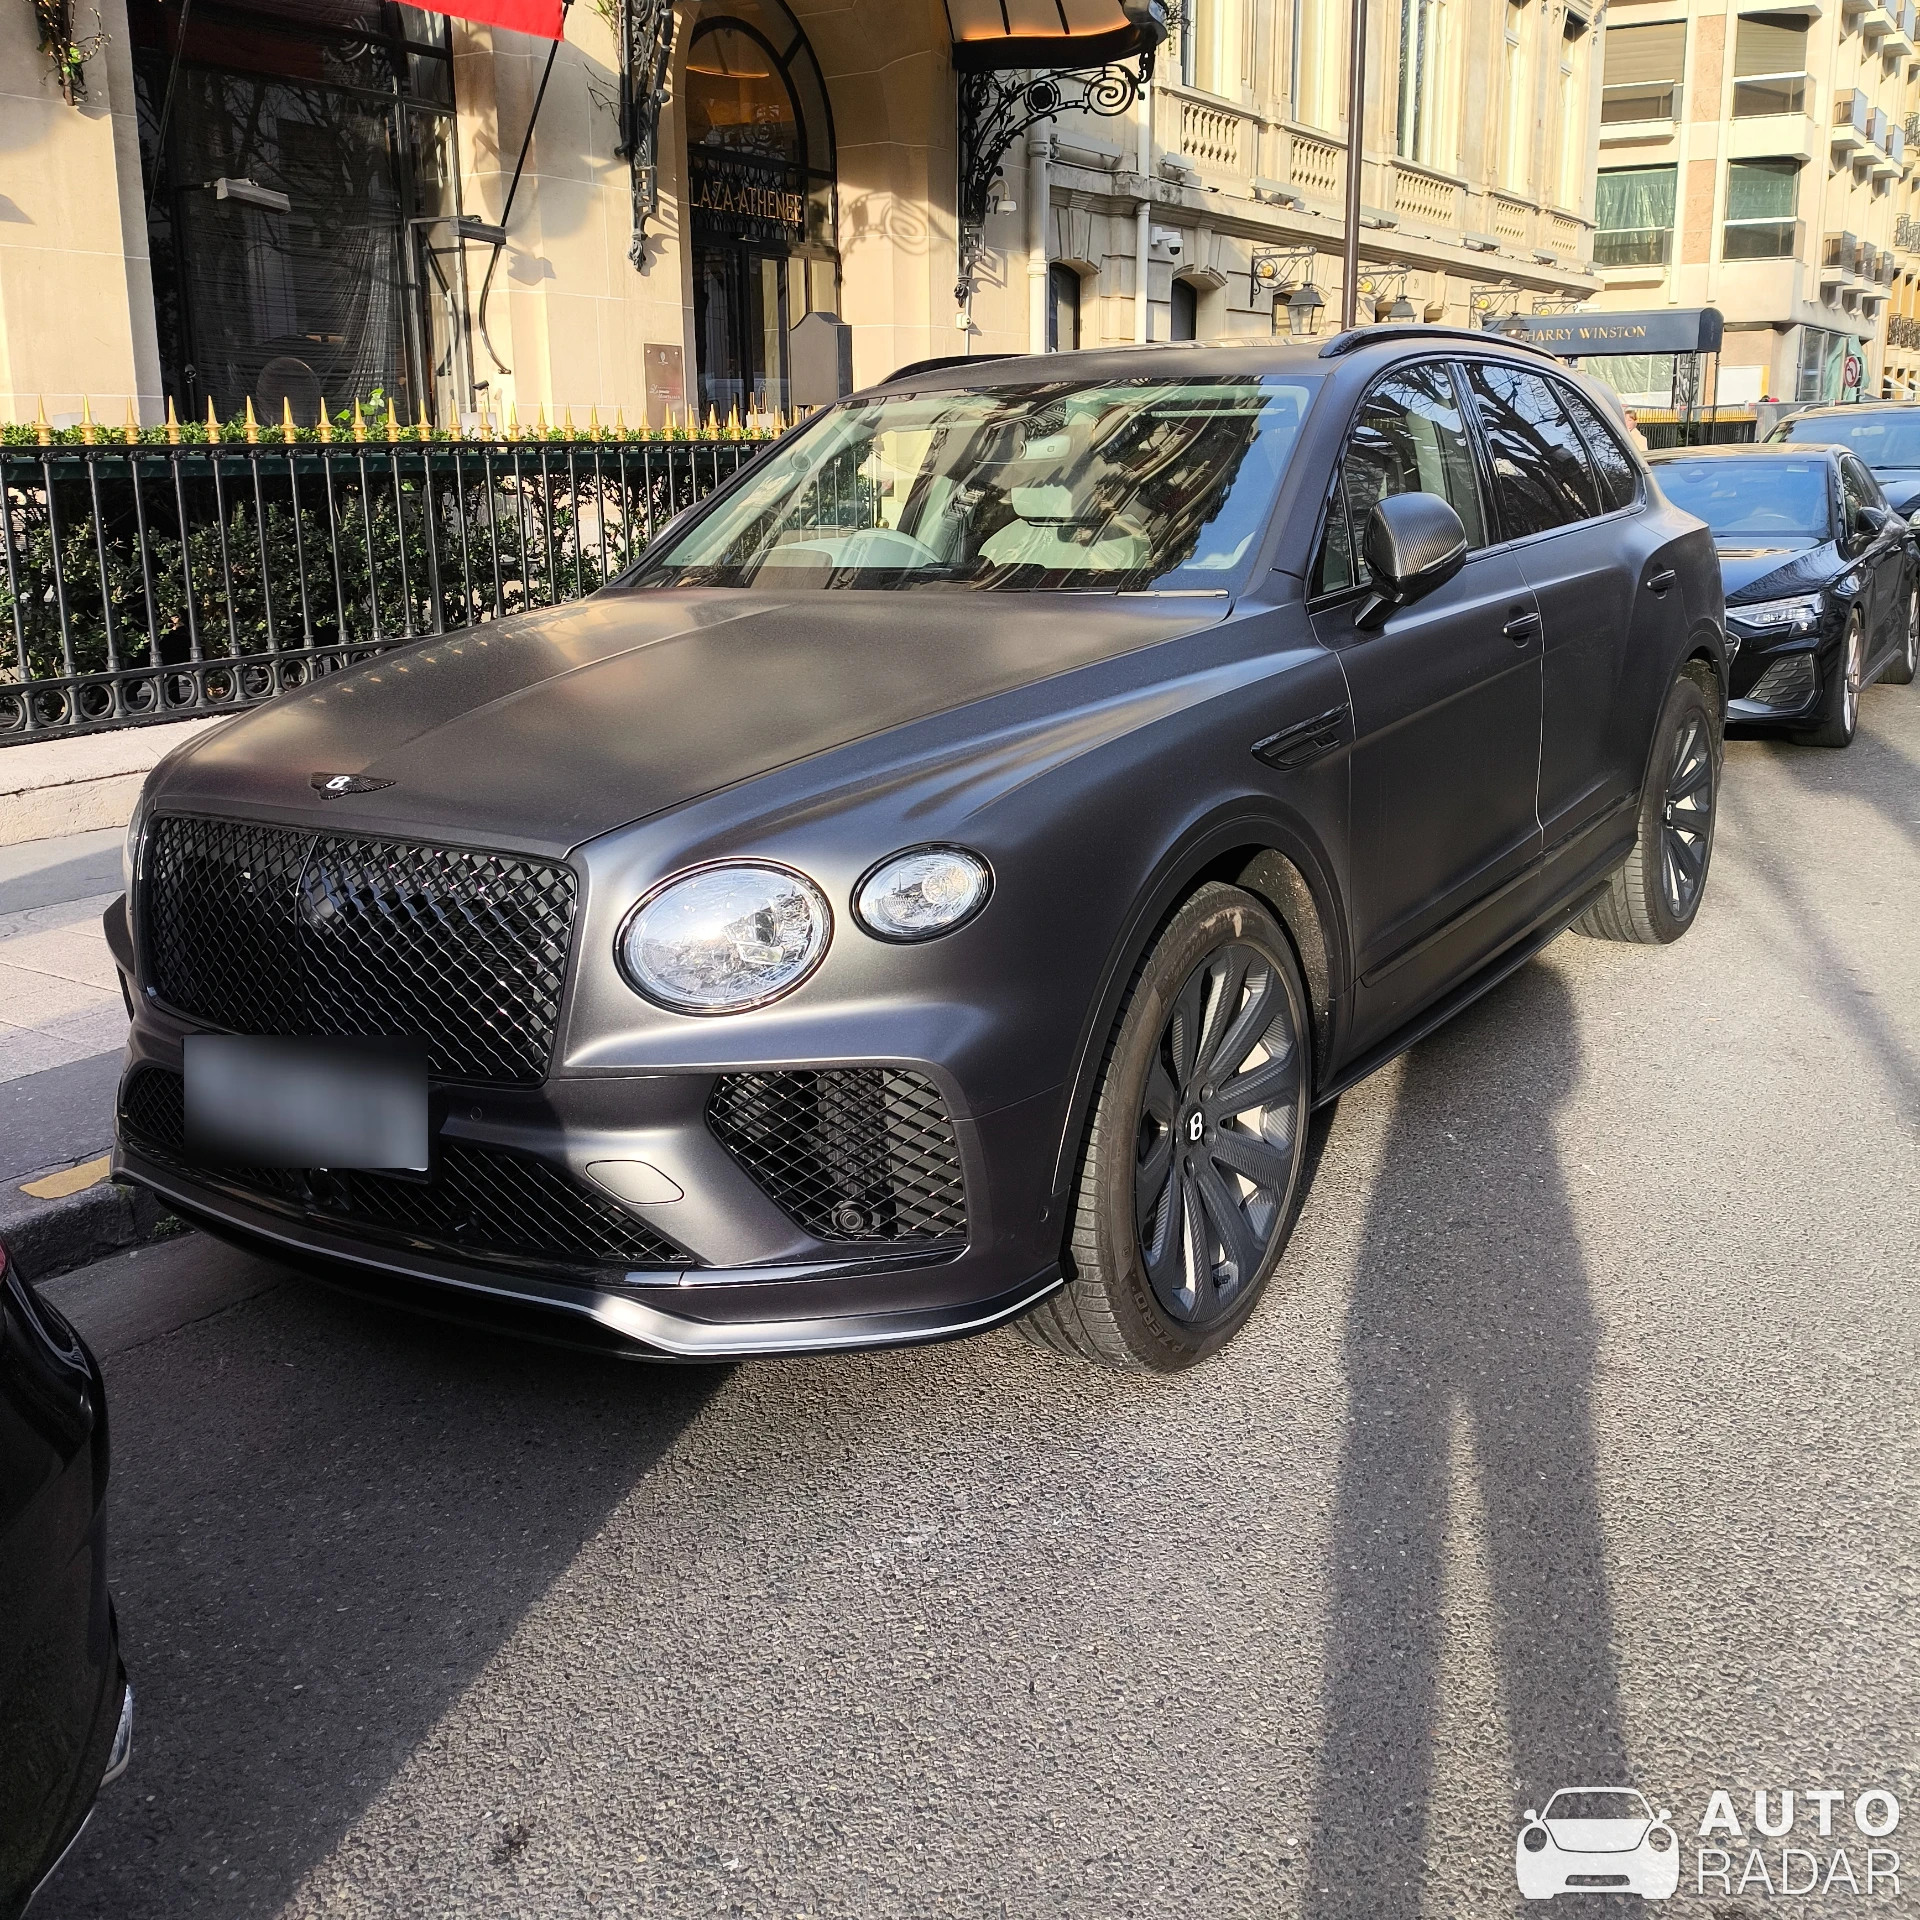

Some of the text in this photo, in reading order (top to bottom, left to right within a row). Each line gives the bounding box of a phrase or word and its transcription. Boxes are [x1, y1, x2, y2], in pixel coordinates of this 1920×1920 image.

[1526, 325, 1647, 341] HARRY WINSTON
[1189, 1111, 1203, 1141] B
